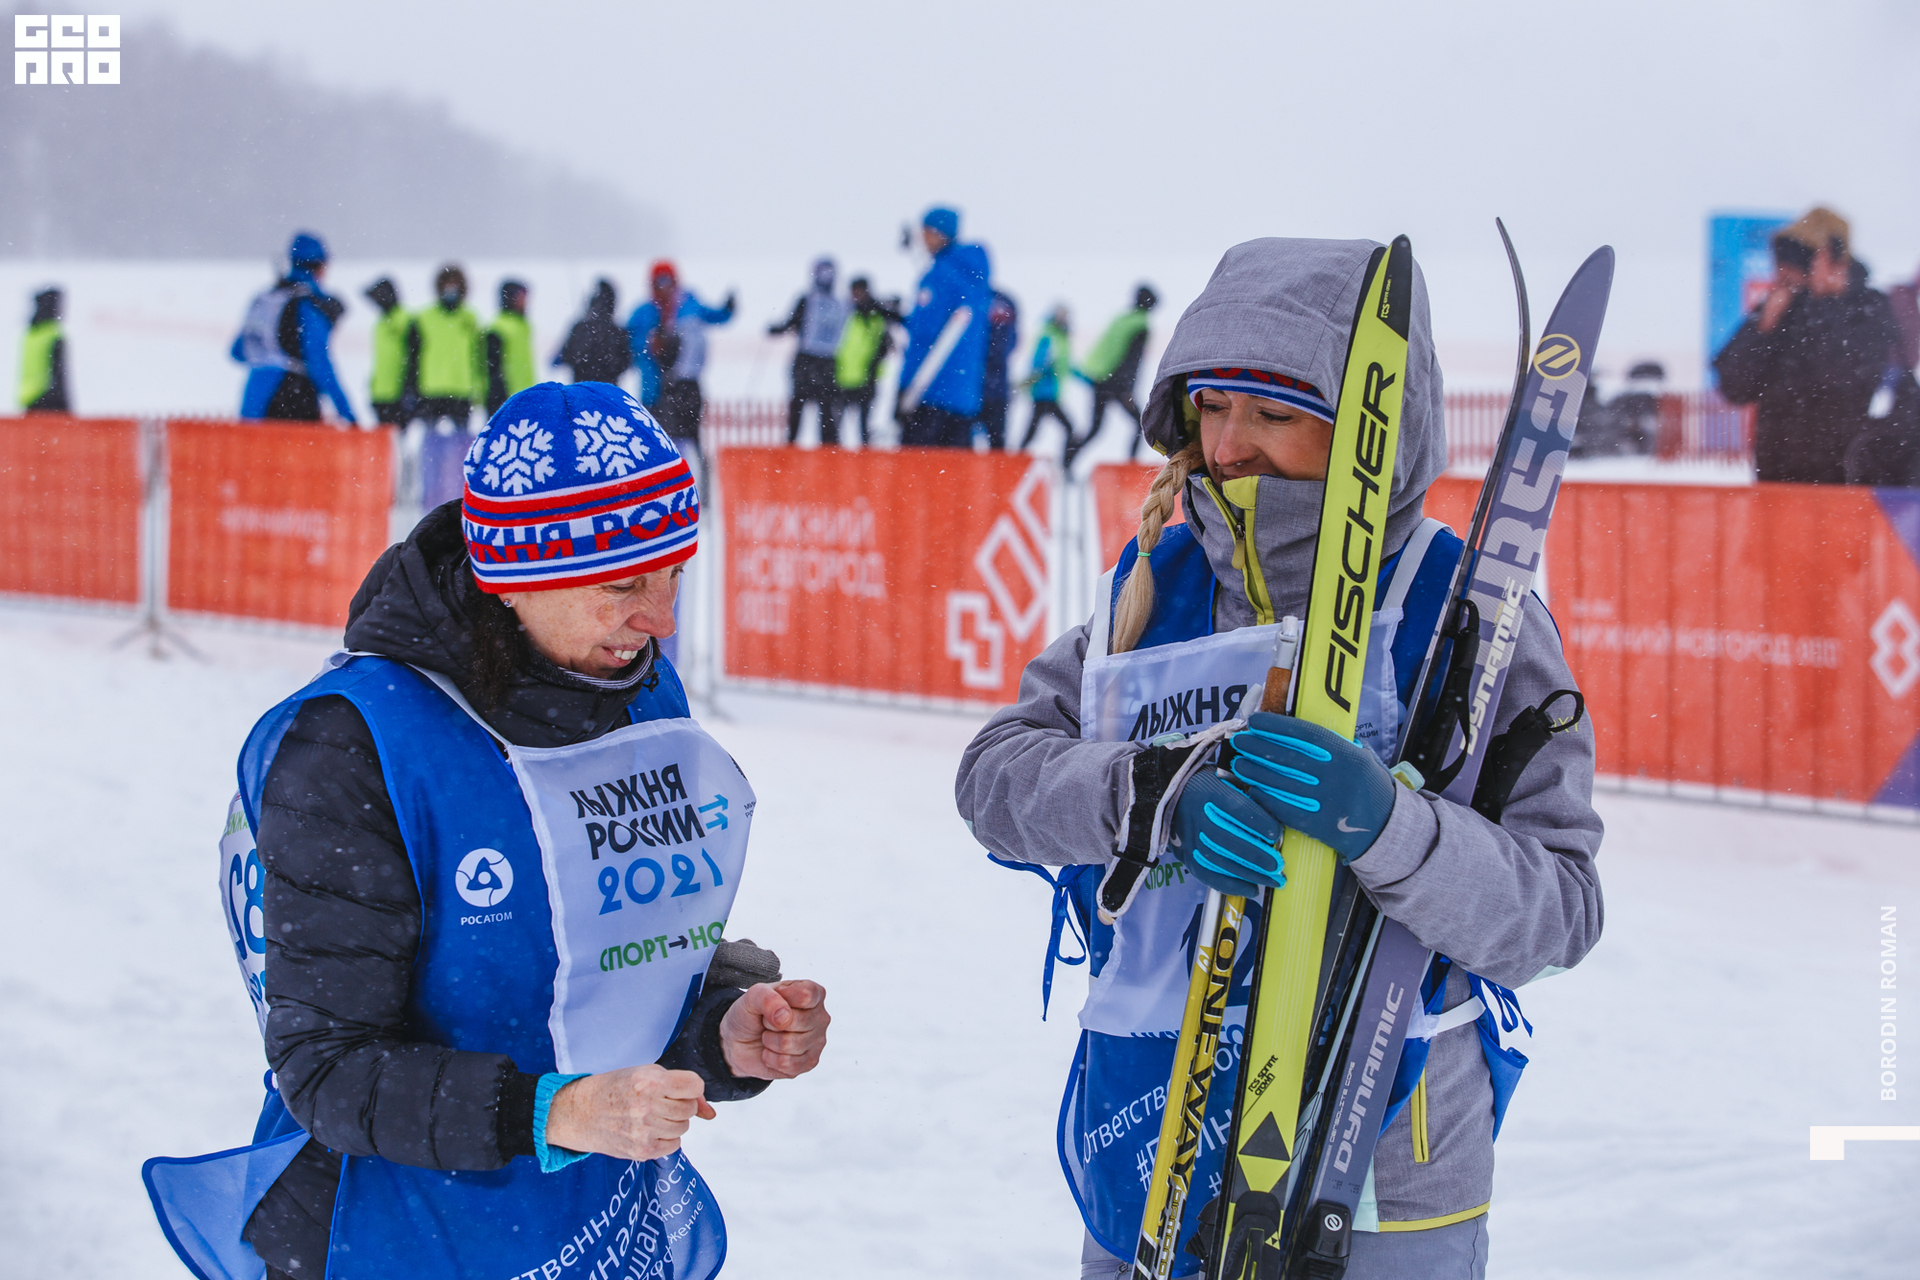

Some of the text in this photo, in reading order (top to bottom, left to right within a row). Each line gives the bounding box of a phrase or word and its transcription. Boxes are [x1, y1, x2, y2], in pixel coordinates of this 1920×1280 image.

[1324, 361, 1396, 713] FISCHER
[1458, 578, 1525, 757] DYNAMIC
[585, 803, 706, 861] РОССИИ
[597, 847, 724, 916] 2021
[460, 911, 513, 926] РОСАТОМ
[1333, 981, 1405, 1174] DYNAMIC
